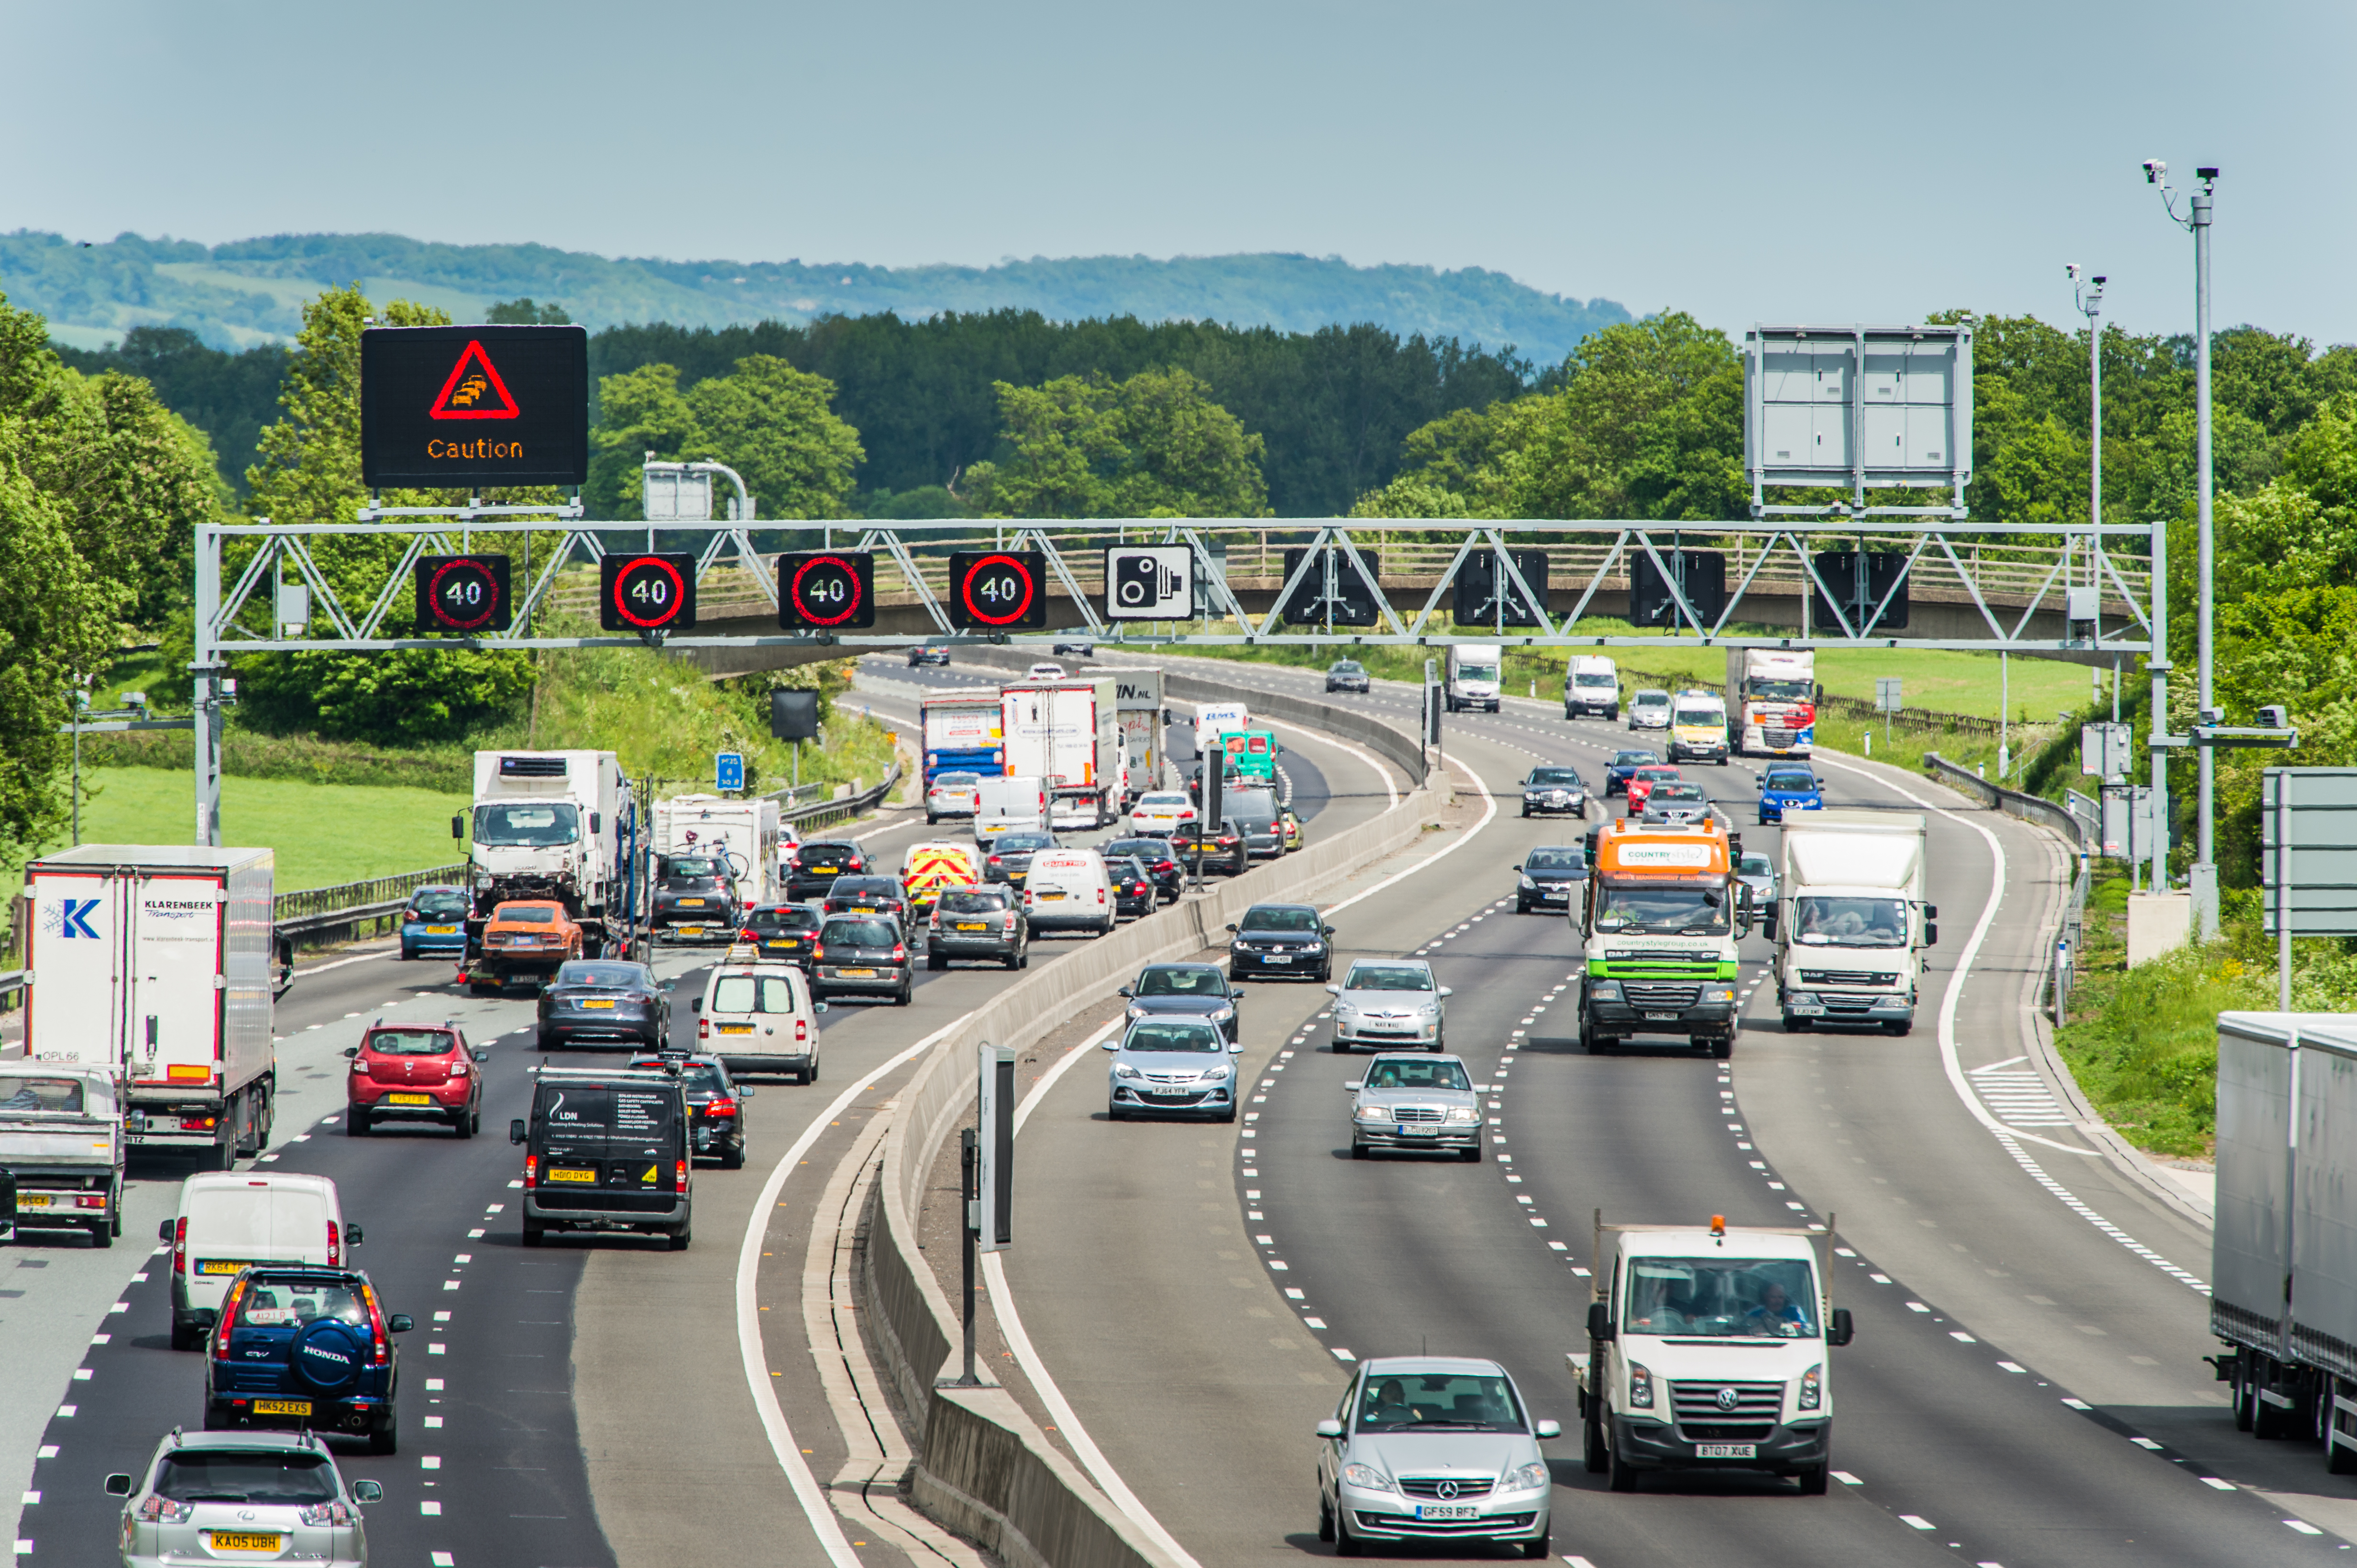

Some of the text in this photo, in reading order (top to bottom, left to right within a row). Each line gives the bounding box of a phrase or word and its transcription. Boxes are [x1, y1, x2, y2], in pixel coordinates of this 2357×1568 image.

[427, 439, 523, 459] Caution
[446, 581, 481, 606] 40
[631, 580, 667, 604] 40
[809, 579, 844, 602] 40
[980, 577, 1016, 602] 40
[145, 900, 212, 909] KLARENBEEK
[145, 910, 194, 920] Transport
[1617, 940, 1708, 948] countrystylegroup.co.uk
[43, 1052, 78, 1061] OPL 66
[206, 1263, 229, 1271] RK64
[303, 1346, 350, 1364] HONDA
[259, 1402, 307, 1413] HK52 EXS
[1702, 1446, 1751, 1456] BT07 XUE
[1424, 1507, 1476, 1517] GF59 BFZ
[216, 1535, 276, 1548] KA05 UBH
